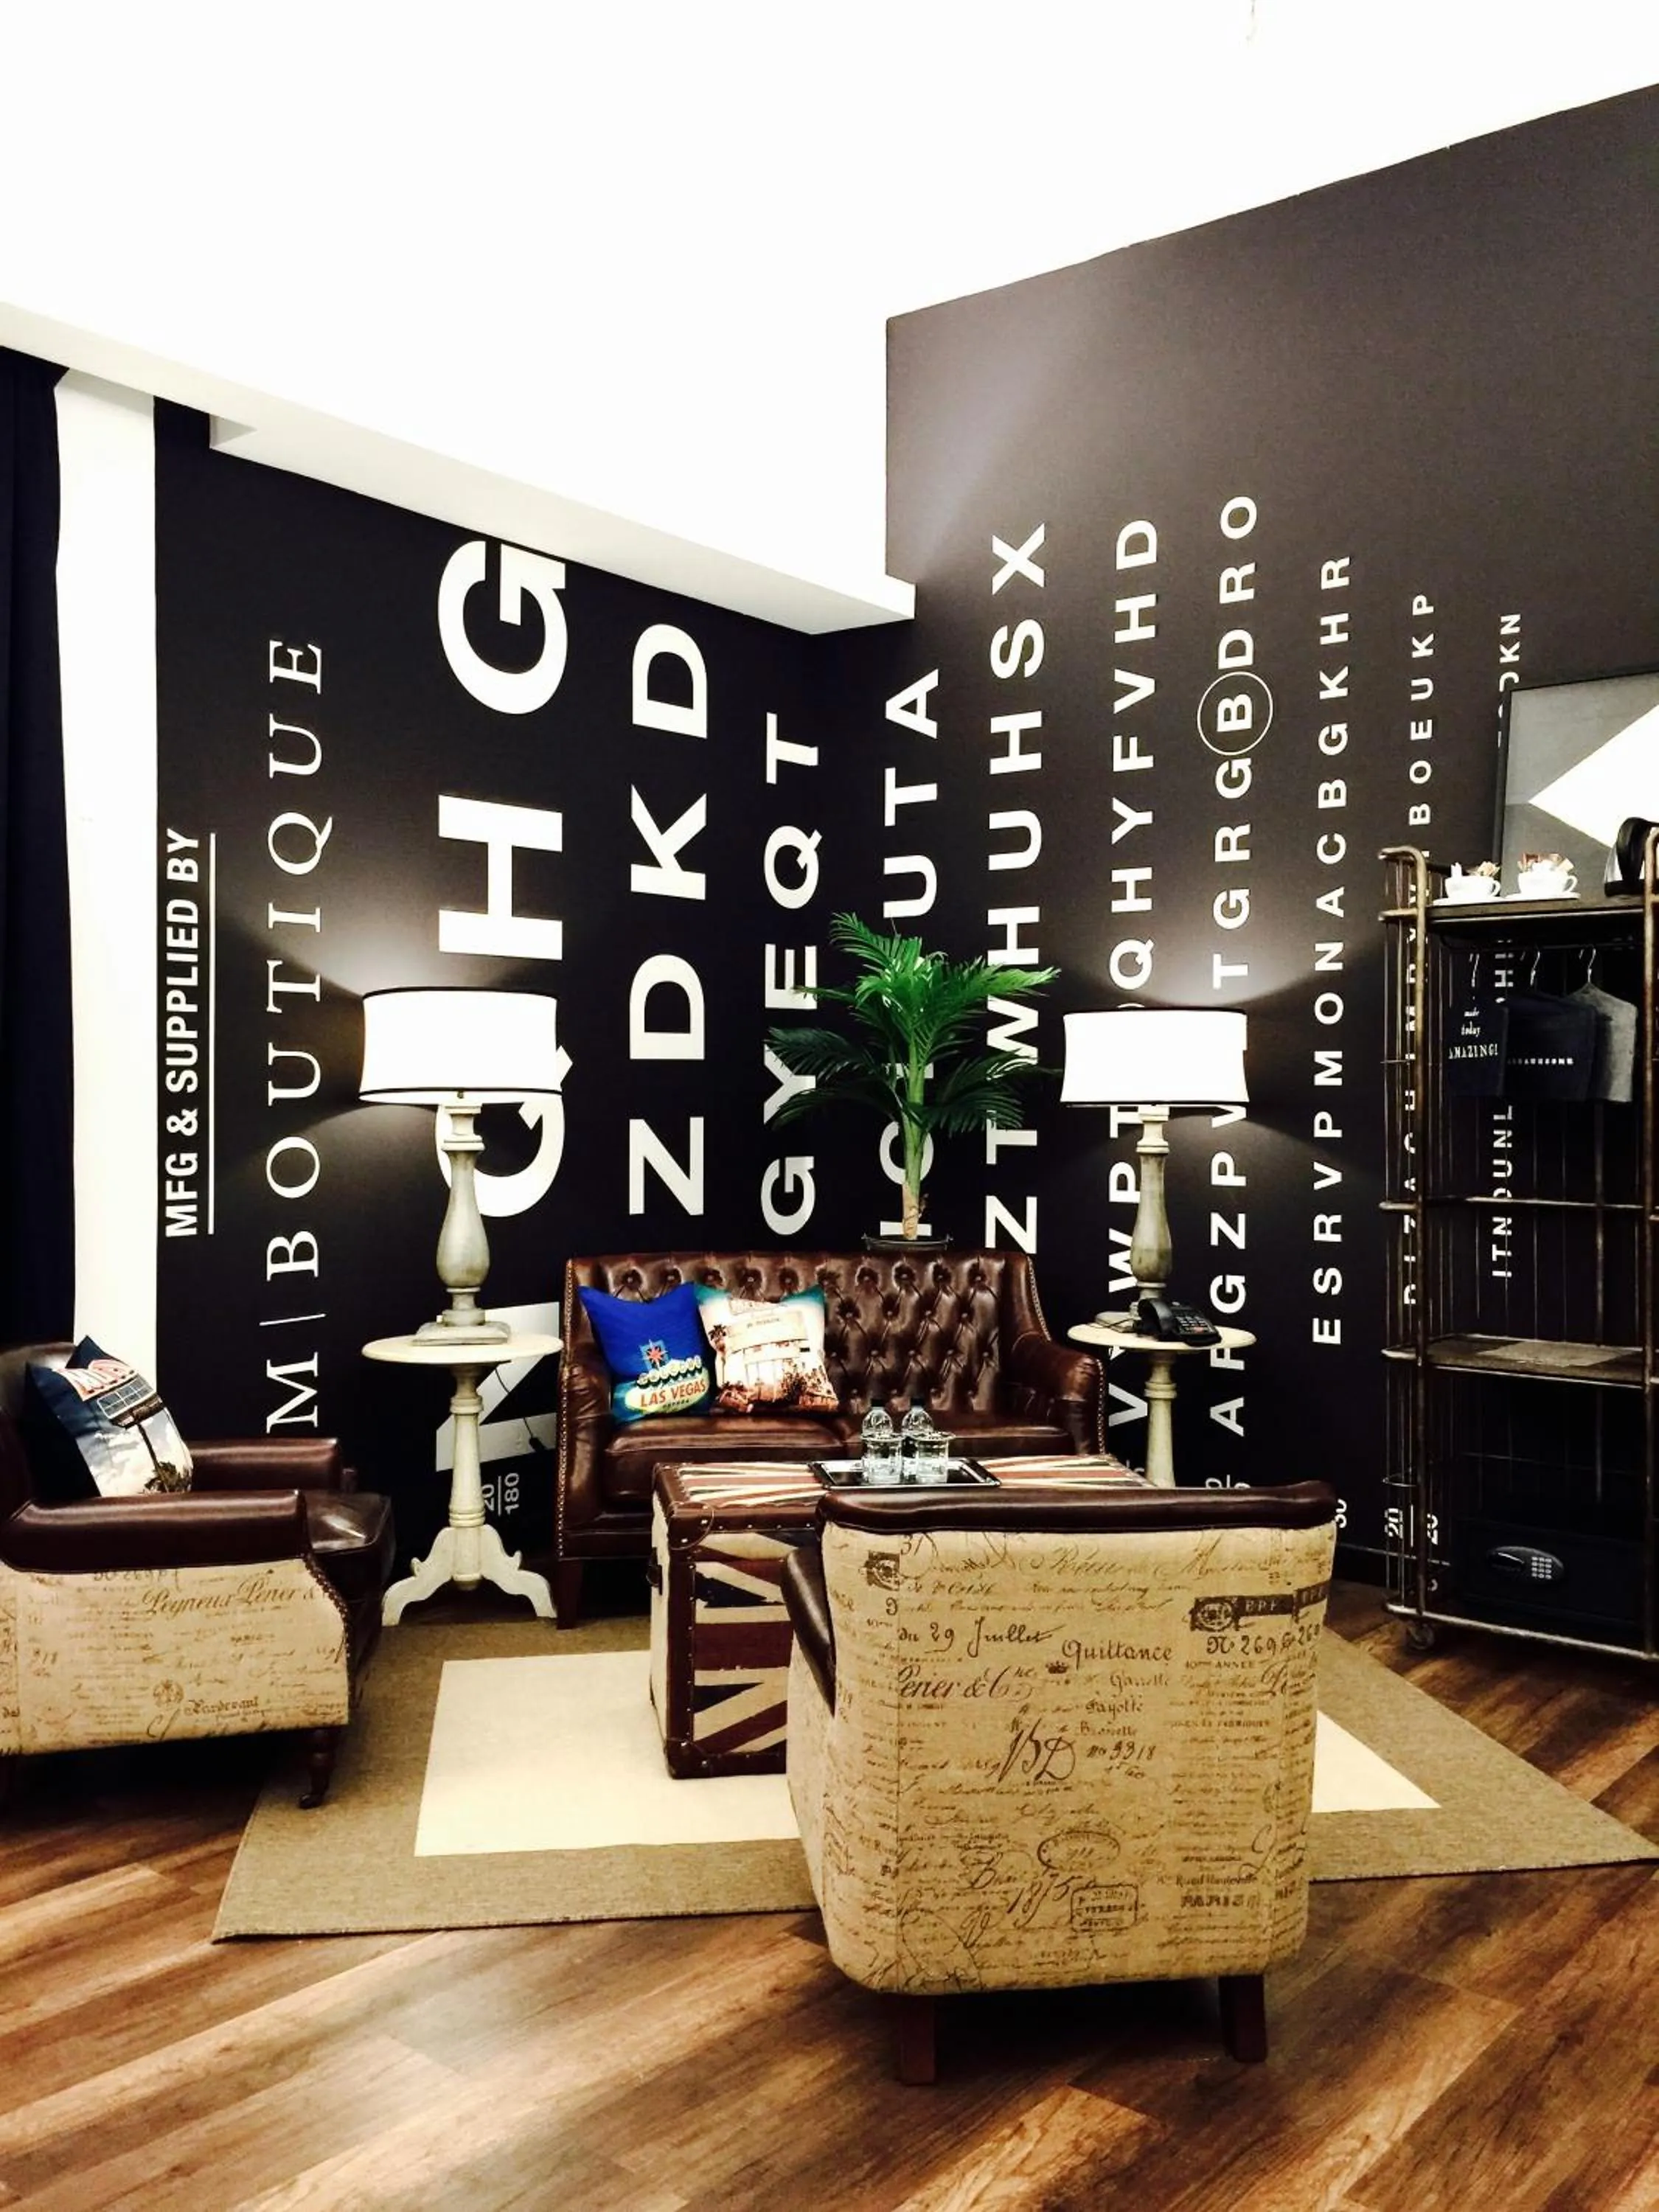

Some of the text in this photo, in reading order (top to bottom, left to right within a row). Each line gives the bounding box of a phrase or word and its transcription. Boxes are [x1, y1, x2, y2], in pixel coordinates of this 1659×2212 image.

[630, 624, 707, 1216] ZDKD
[166, 828, 198, 1237] MFG & SUPPLIED BY
[1447, 1043, 1499, 1060] AMAZING!
[640, 1391, 667, 1408] LAS
[670, 1378, 706, 1399] VEGAS
